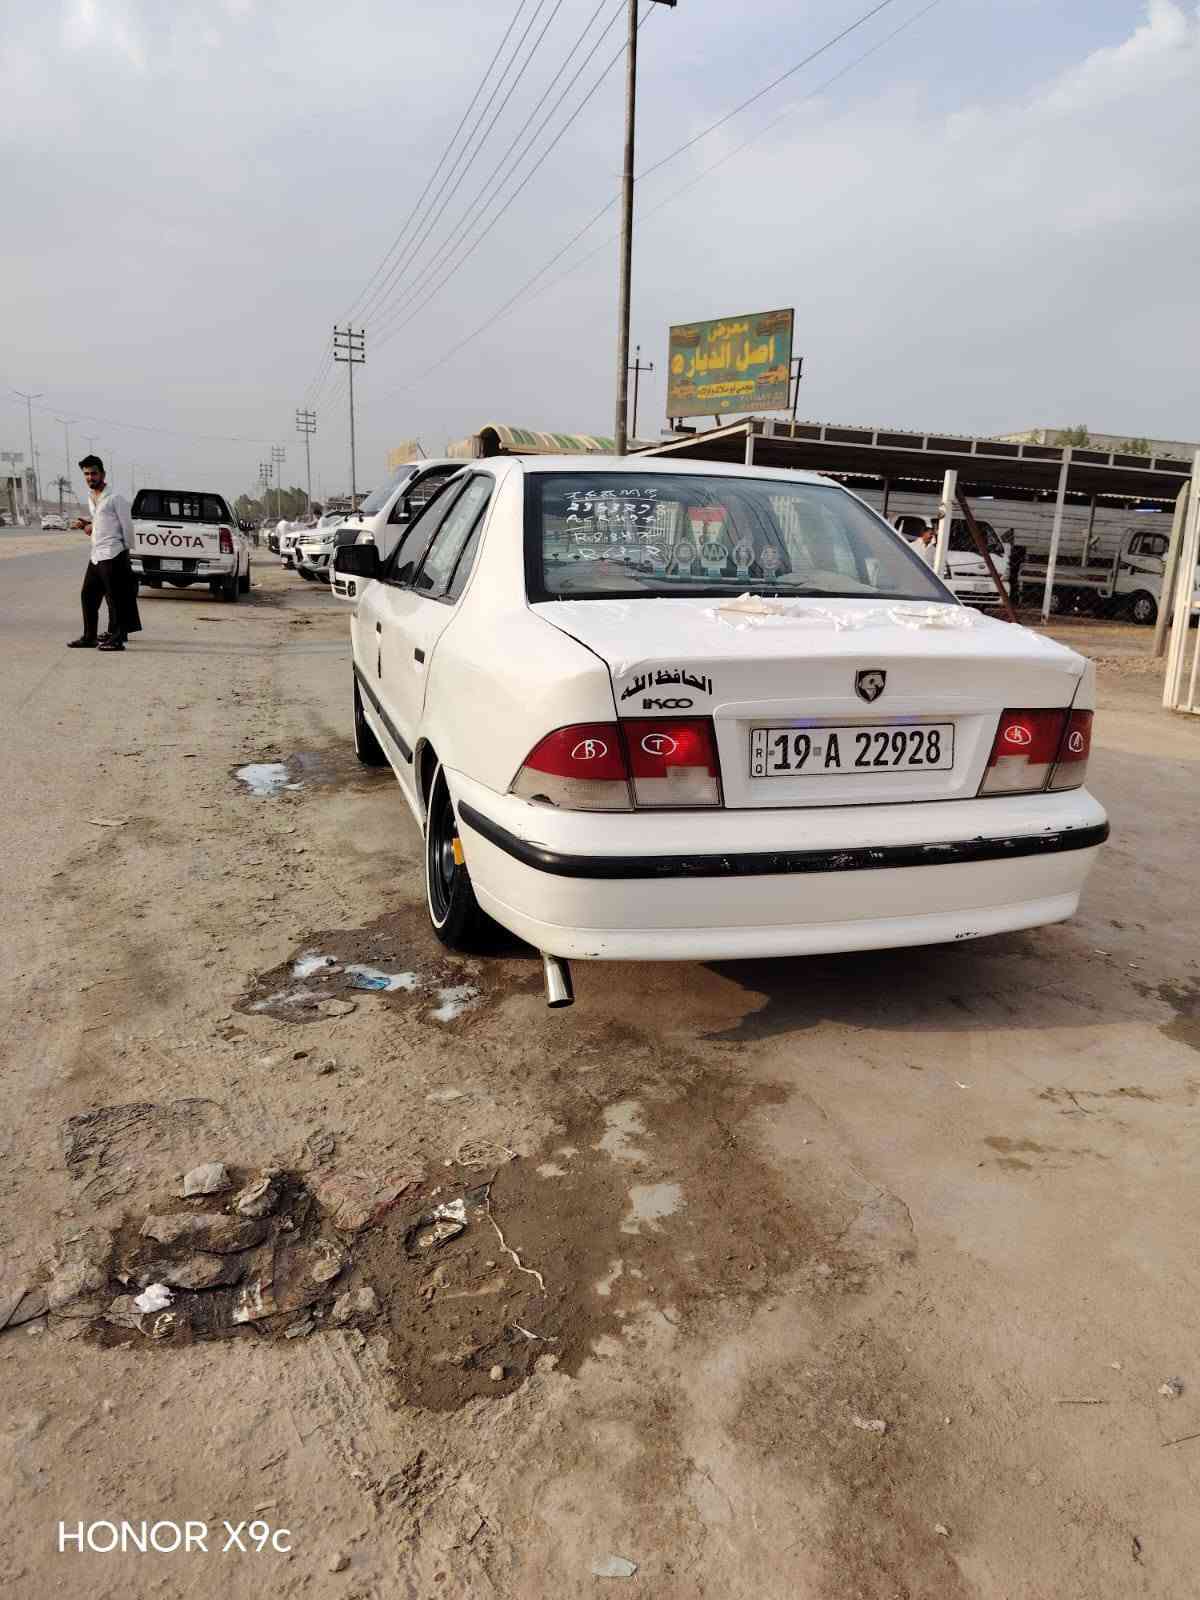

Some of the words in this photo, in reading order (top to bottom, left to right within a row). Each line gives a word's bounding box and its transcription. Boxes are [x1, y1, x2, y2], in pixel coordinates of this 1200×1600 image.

[136, 533, 204, 548] TOYOTA
[621, 671, 653, 700] الله
[655, 669, 712, 696] الحافظ
[642, 698, 693, 710] IKCO
[774, 734, 811, 770] 19
[824, 732, 841, 768] A
[854, 729, 941, 767] 22928
